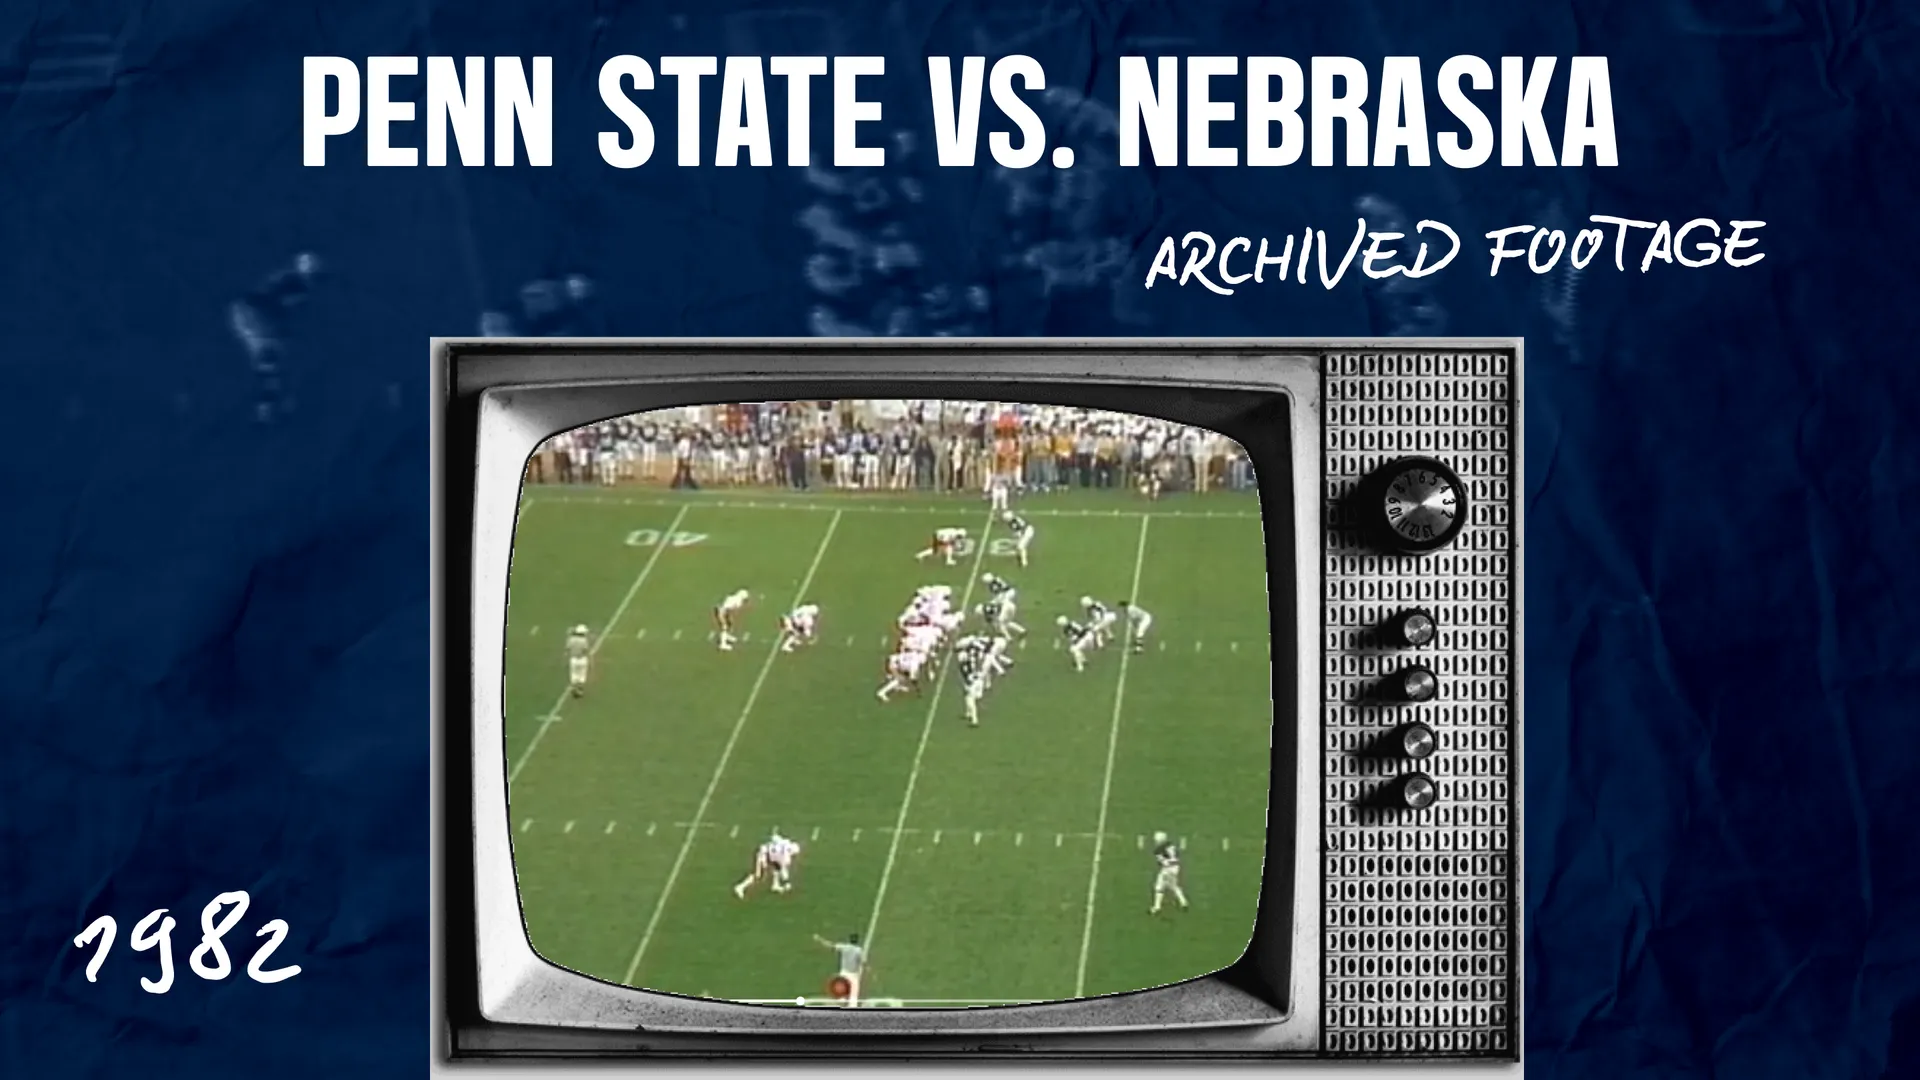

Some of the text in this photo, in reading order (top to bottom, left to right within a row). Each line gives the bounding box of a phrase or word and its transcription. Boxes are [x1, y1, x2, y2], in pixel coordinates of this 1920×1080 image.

[1388, 507, 1403, 520] 10
[1419, 471, 1426, 484] 6
[1441, 509, 1454, 519] 2
[624, 528, 709, 547] 40
